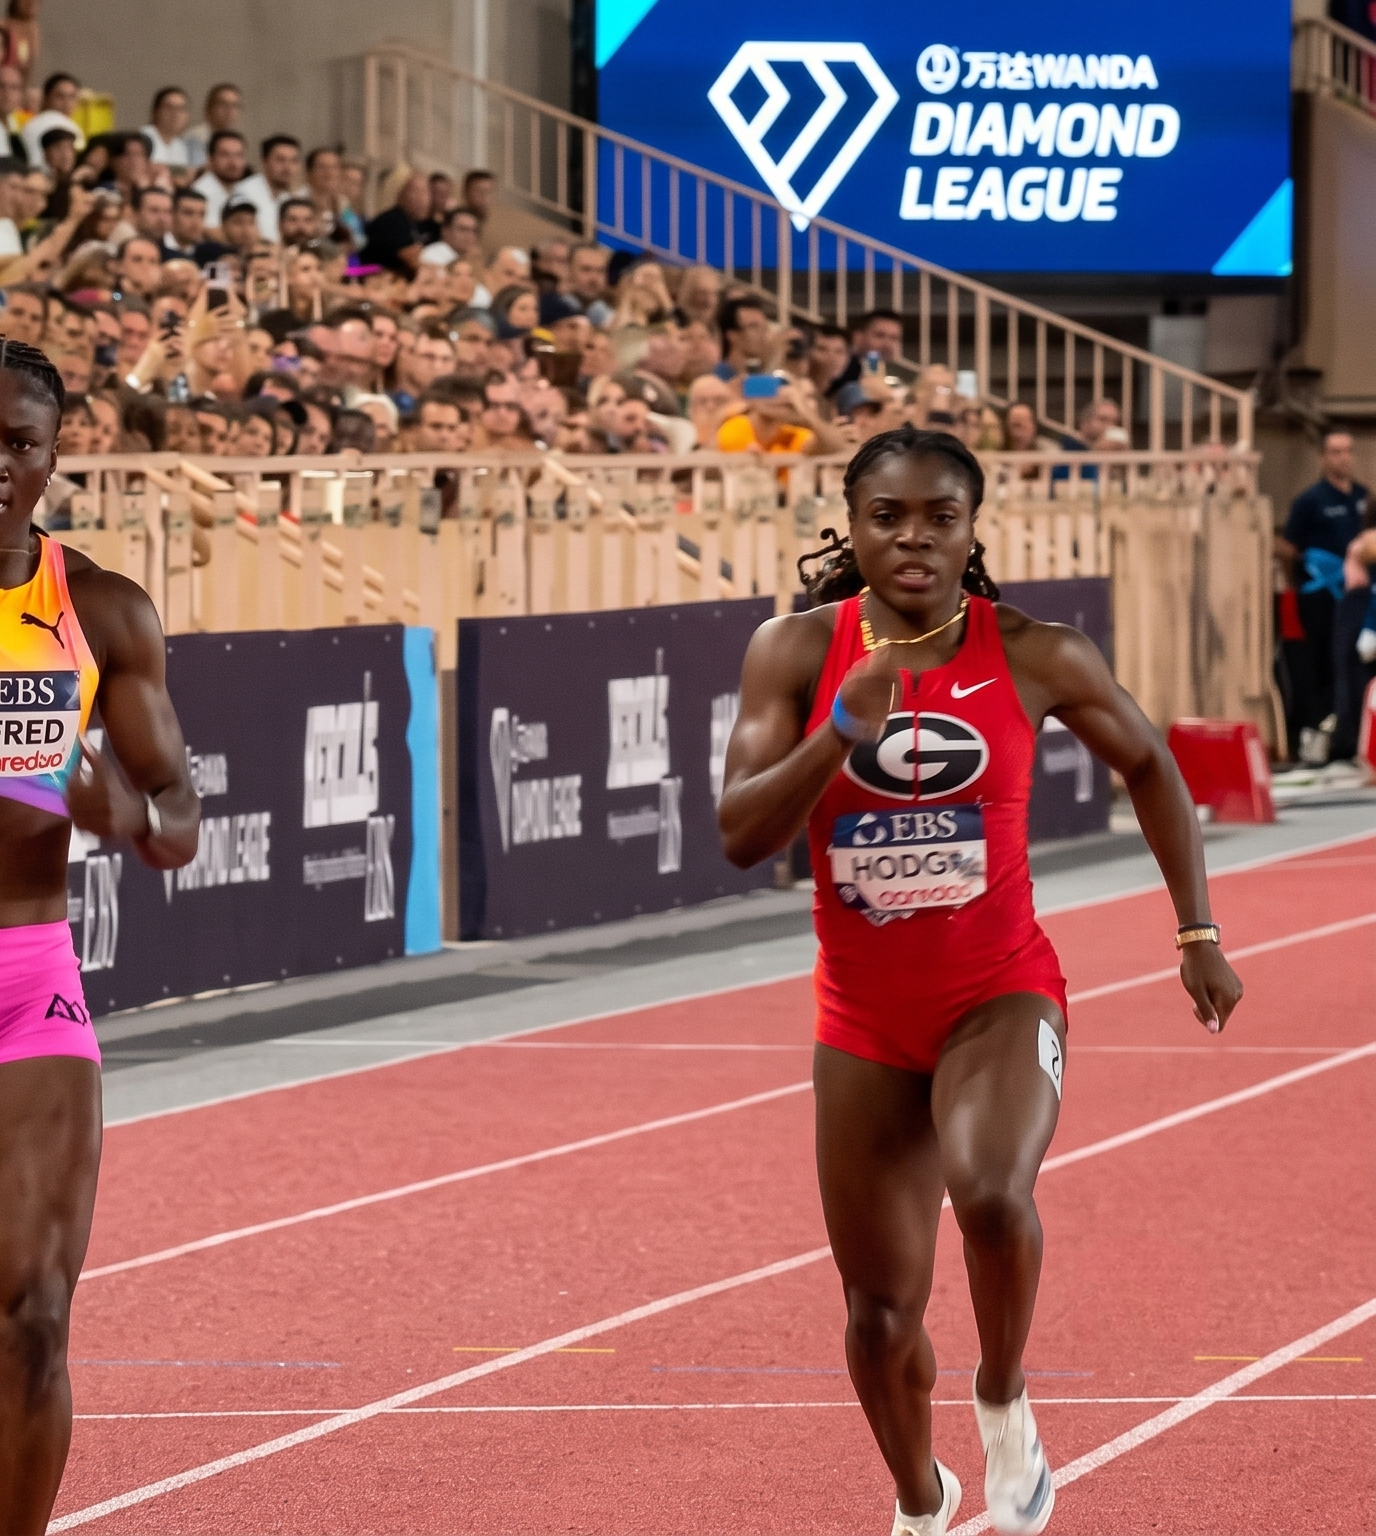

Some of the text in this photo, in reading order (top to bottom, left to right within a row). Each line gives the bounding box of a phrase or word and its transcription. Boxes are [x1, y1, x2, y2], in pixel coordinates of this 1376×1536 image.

[1032, 53, 1159, 90] WANDA
[910, 101, 1181, 158] DIAMOND
[899, 166, 1124, 222] LEAGUE
[889, 810, 958, 842] EBS
